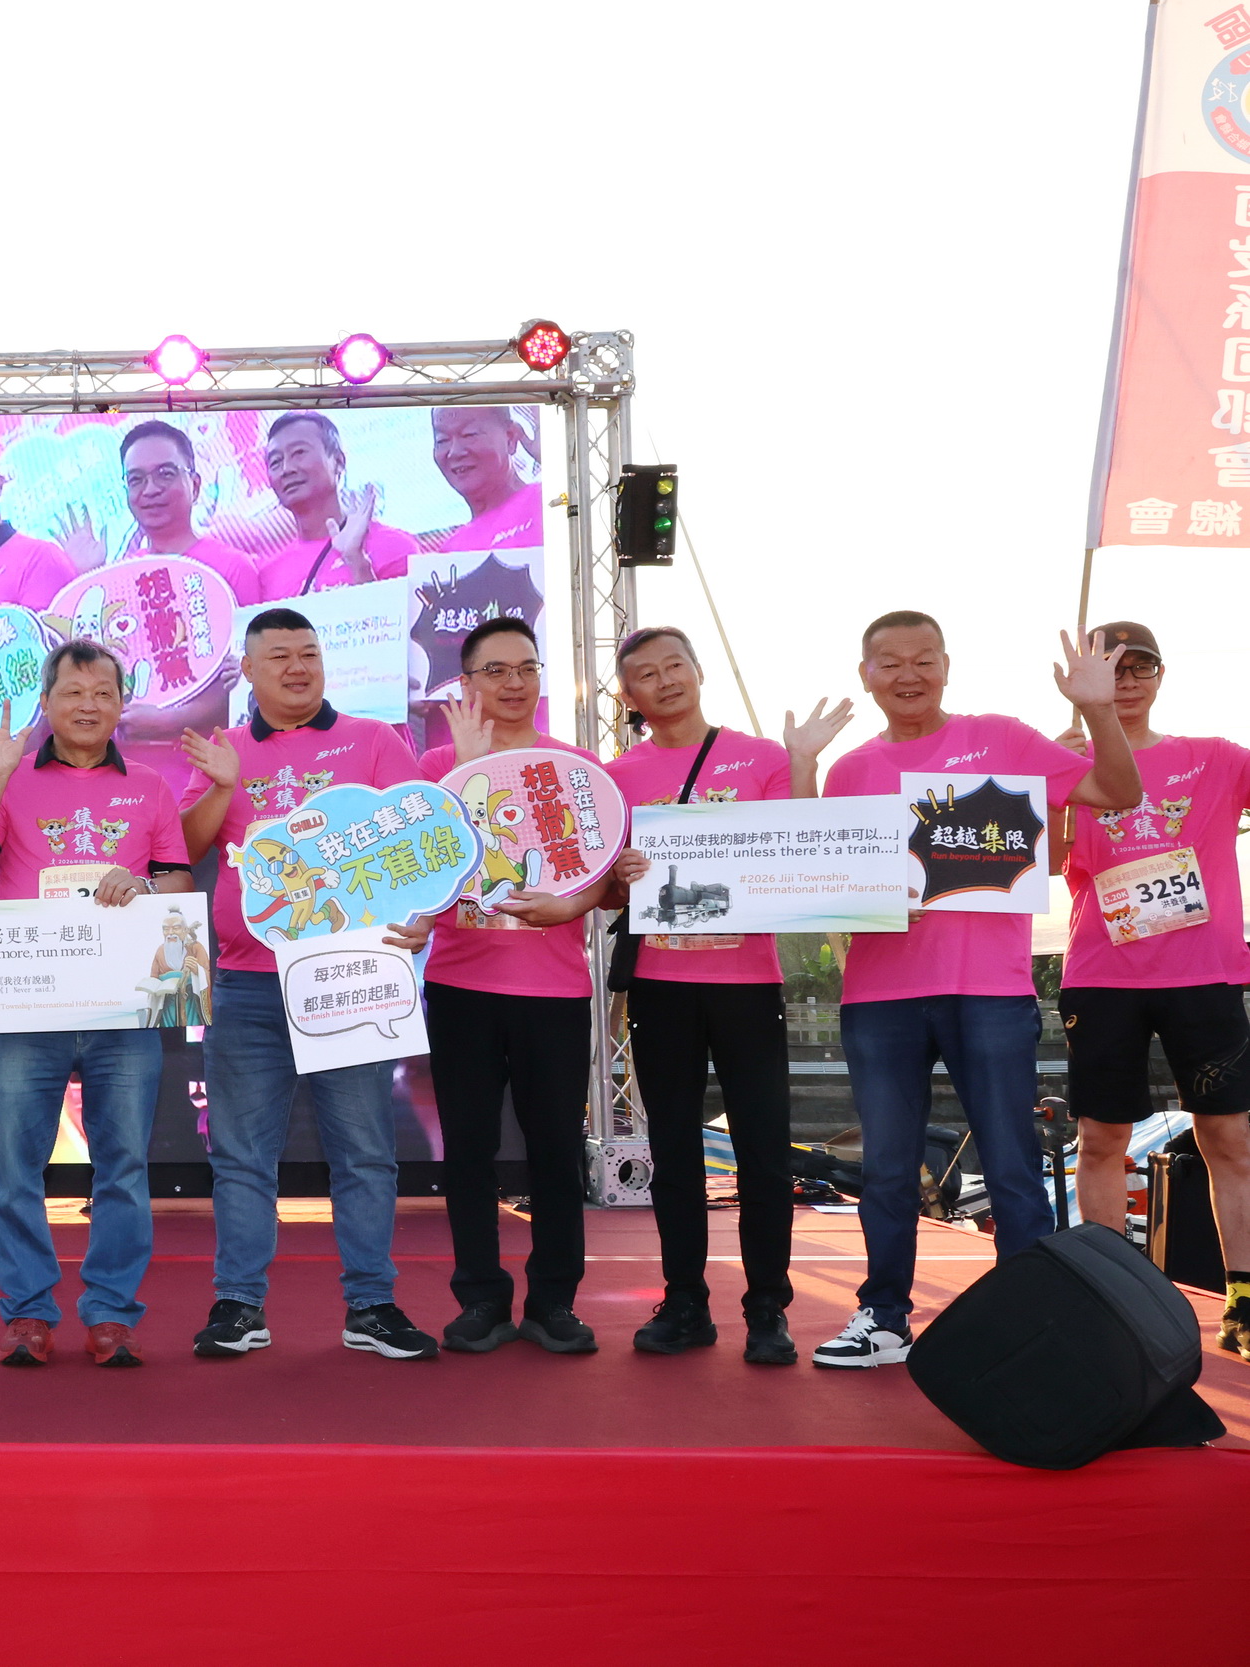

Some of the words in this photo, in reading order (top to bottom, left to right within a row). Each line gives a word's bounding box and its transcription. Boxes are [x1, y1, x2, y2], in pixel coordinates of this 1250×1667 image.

[568, 767, 605, 851] 我在集集
[71, 807, 97, 856] 集集
[315, 791, 434, 866] 我在集集
[520, 761, 590, 882] 想撒蕉
[930, 819, 1028, 854] 超越集限
[339, 825, 466, 901] 不蕉綠
[733, 847, 776, 858] unless
[835, 847, 843, 855] a
[950, 852, 981, 861] beyond
[982, 854, 1002, 863] your
[1003, 854, 1028, 863] limits.
[739, 874, 776, 884] #2026
[778, 873, 794, 883] Jiji
[797, 872, 850, 882] Township
[748, 884, 818, 895] International
[821, 883, 845, 893] Half
[847, 883, 902, 893] Marathon
[1135, 871, 1200, 903] 3254
[46, 890, 69, 898] 5.20K
[1104, 890, 1129, 904] 5.20K
[36, 949, 58, 958] run
[314, 958, 378, 982] 每次終點
[2, 1002, 32, 1010] Township
[34, 1001, 73, 1009] International
[75, 1000, 90, 1008] Half
[91, 1000, 122, 1008] Marathon
[303, 982, 400, 1013] 都是新的起點
[311, 1012, 330, 1020] finish
[332, 1009, 345, 1017] line
[375, 999, 413, 1011] beginning.
